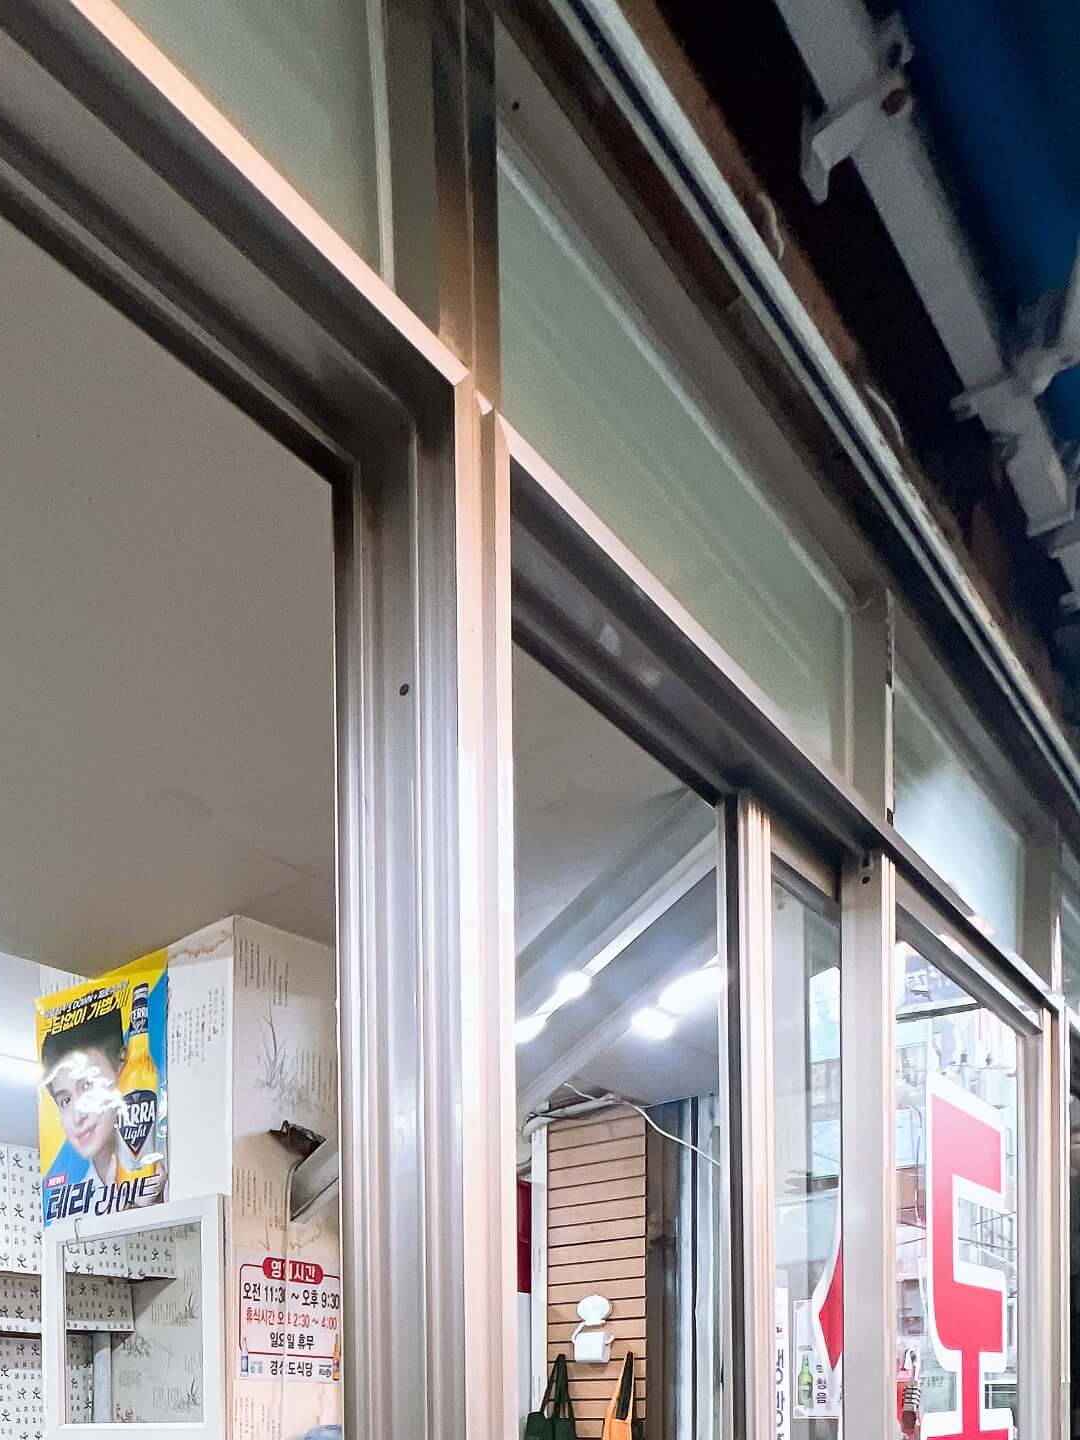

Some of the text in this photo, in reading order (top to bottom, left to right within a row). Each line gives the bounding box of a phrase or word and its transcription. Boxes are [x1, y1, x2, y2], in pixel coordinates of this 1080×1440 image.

[124, 1123, 147, 1145] Light
[271, 1260, 316, 1283] 영시간
[243, 1283, 261, 1302] 오전
[302, 1289, 319, 1308] 오후
[298, 1333, 315, 1350] 휴무
